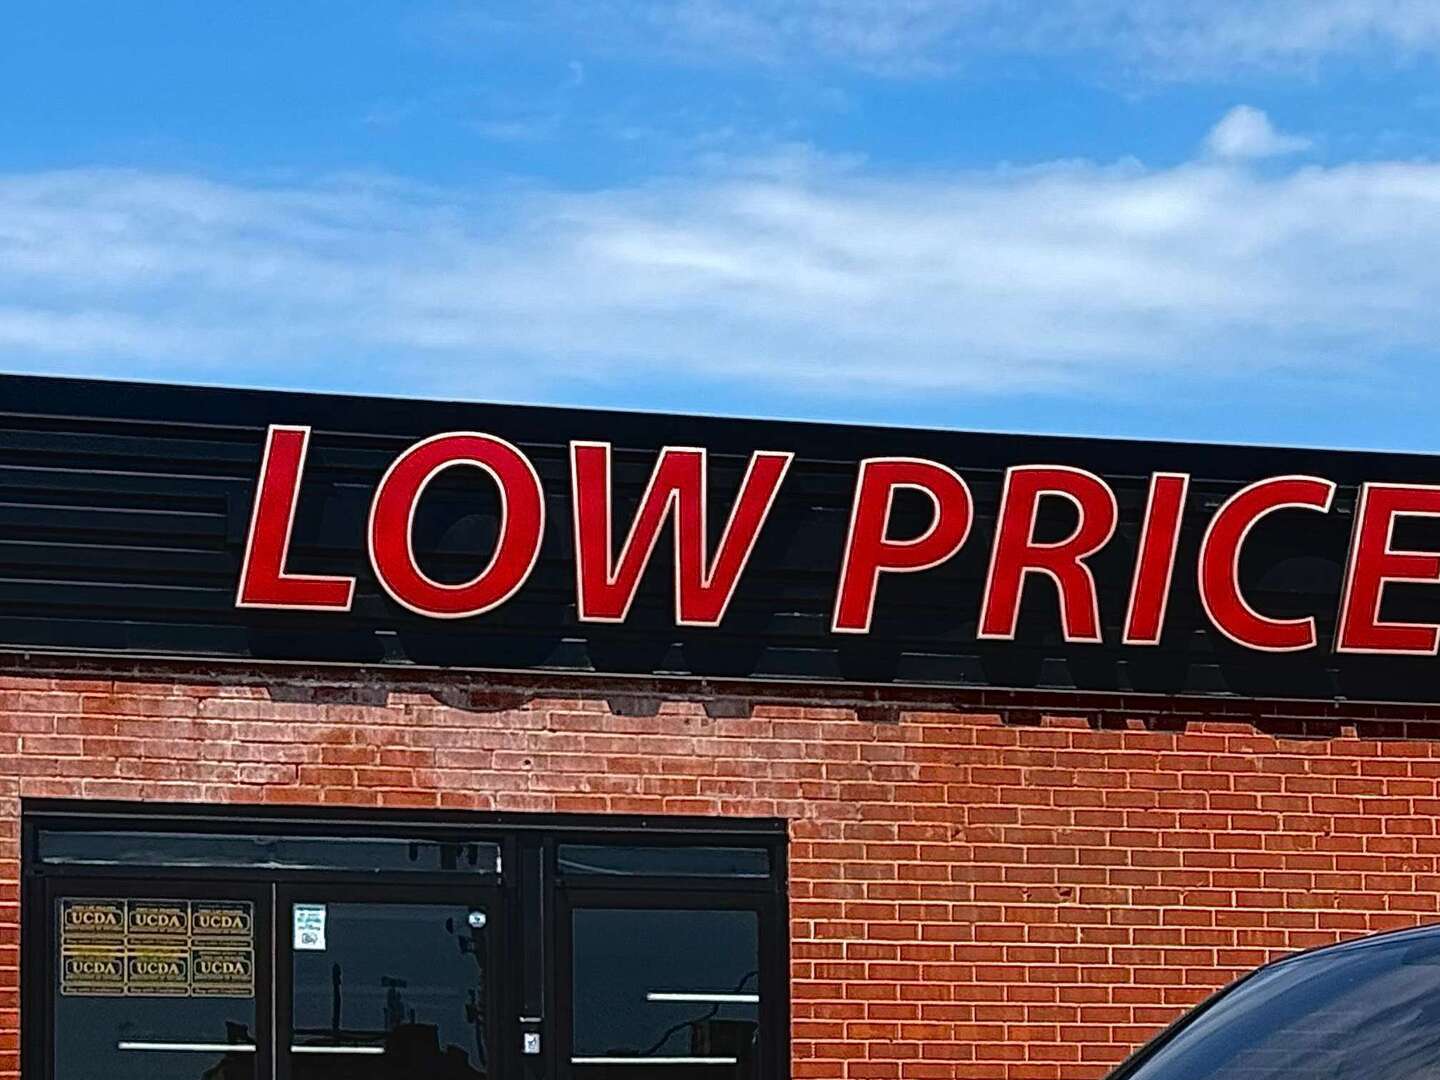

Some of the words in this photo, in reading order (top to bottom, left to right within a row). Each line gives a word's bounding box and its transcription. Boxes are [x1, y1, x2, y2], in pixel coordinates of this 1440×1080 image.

[235, 423, 795, 627] LOW
[72, 911, 118, 925] UCDA
[136, 914, 180, 928] UCDA
[200, 916, 244, 930] UCDA
[72, 961, 117, 975] UCDA
[136, 961, 180, 975] UCDA
[201, 961, 246, 975] UCDA
